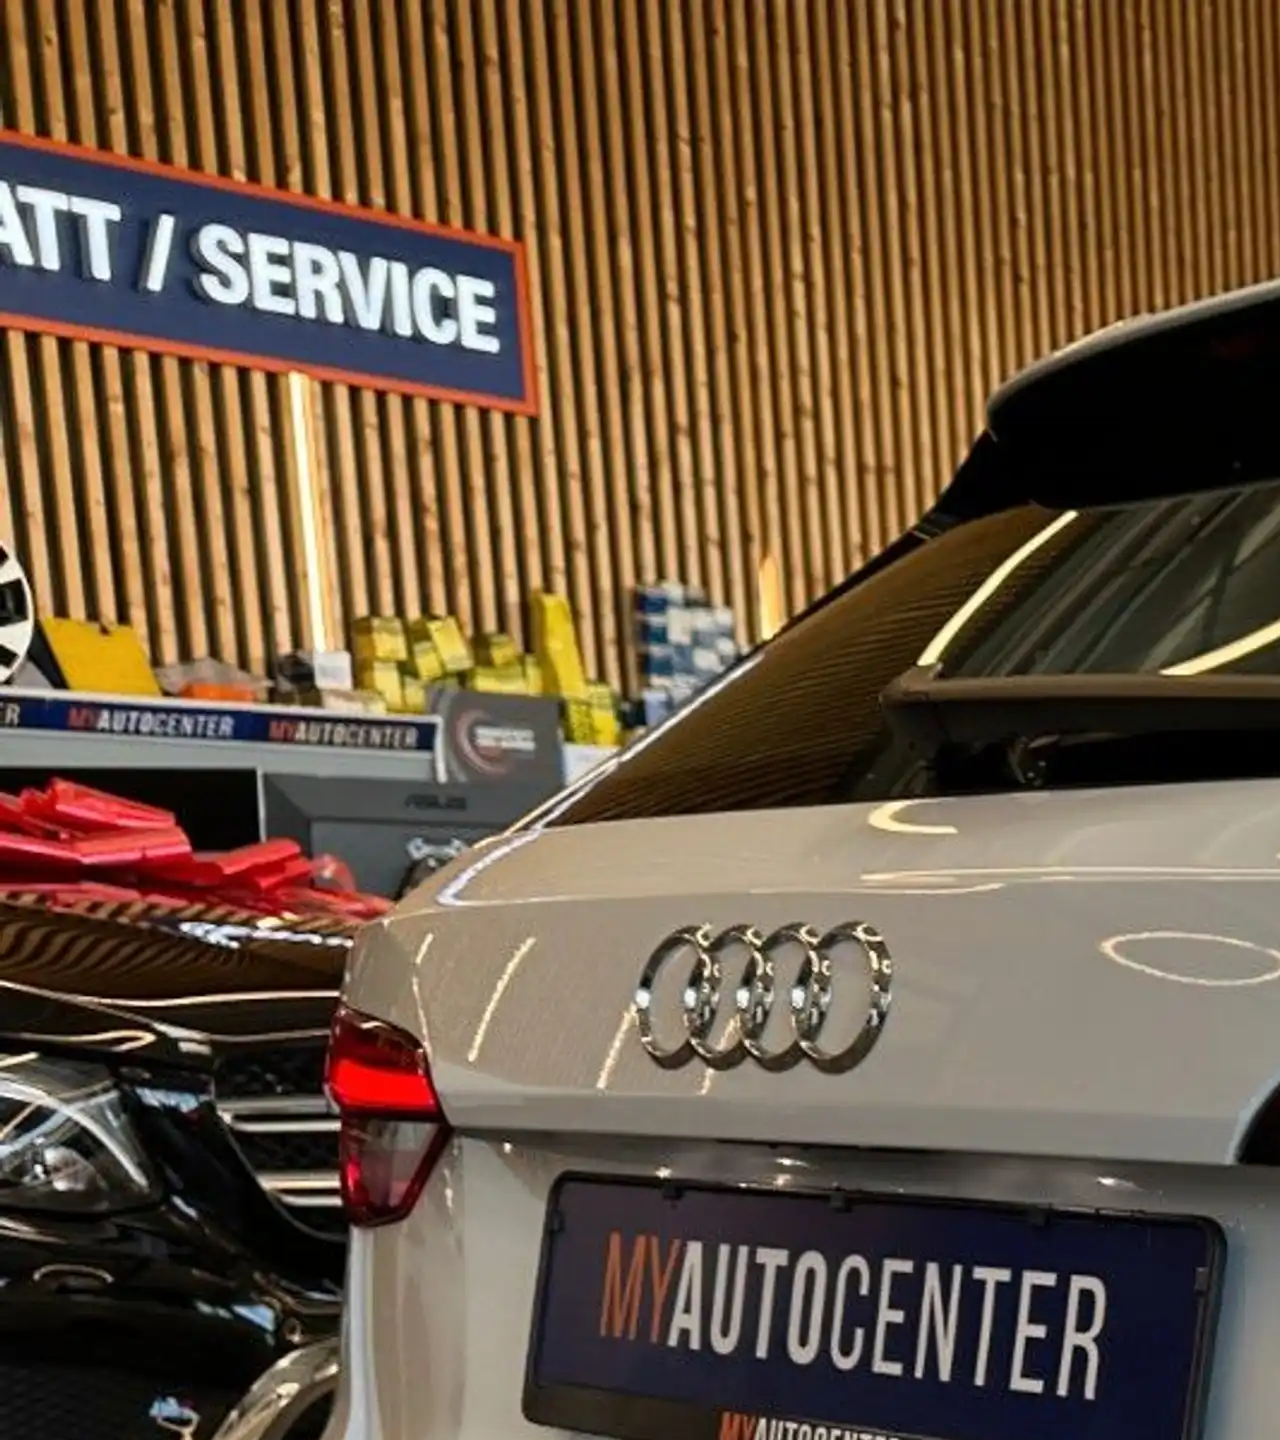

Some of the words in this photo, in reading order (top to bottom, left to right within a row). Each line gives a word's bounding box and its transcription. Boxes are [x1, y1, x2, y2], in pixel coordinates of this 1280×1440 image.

[147, 212, 175, 292] /
[198, 222, 500, 354] SERVICE
[67, 707, 236, 738] MYAUTOCENTER
[600, 1230, 1107, 1401] MYAUTOCENTER
